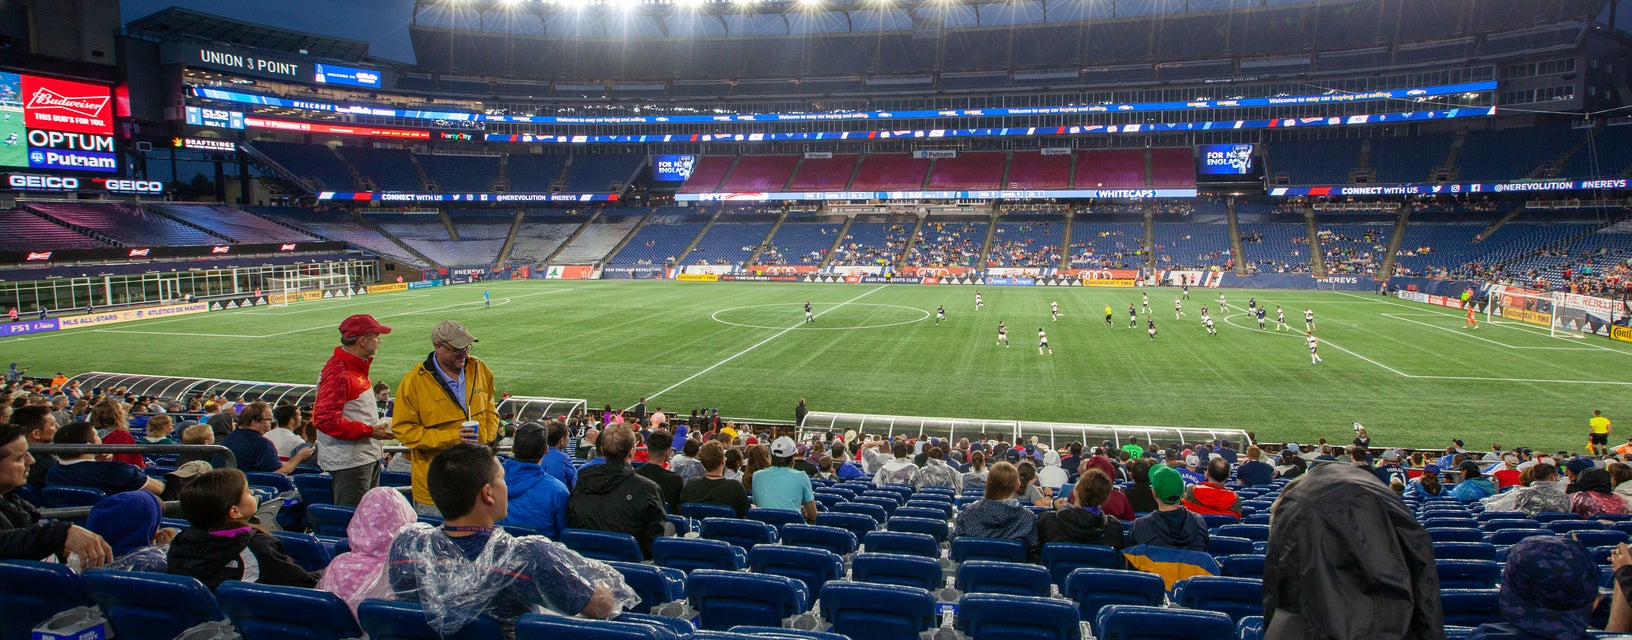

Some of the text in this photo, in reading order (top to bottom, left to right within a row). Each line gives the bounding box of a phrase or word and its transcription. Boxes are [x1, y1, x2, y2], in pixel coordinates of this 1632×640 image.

[201, 50, 243, 68] UNION
[258, 59, 298, 76] POINT
[32, 91, 102, 110] Budweiser
[1332, 93, 1354, 102] buying
[293, 102, 331, 110] WELCOME
[34, 112, 51, 121] THIS
[52, 114, 74, 123] BUD'S
[28, 130, 114, 152] OPTUM
[440, 132, 472, 140] PartyCity
[185, 138, 235, 148] DRAFTKINGS
[46, 152, 116, 168] Putnam
[9, 175, 78, 189] GEICO
[105, 179, 163, 191] GEICO
[1494, 180, 1626, 192] @NEREVOLUTION #NEREVS
[1099, 190, 1153, 198] WHITECAPS
[368, 284, 394, 293] Continental
[148, 306, 175, 316] ATLÉTICO
[1505, 308, 1532, 320] Continental
[62, 314, 118, 326] MLS ALL-STARS
[10, 324, 30, 332] FS1
